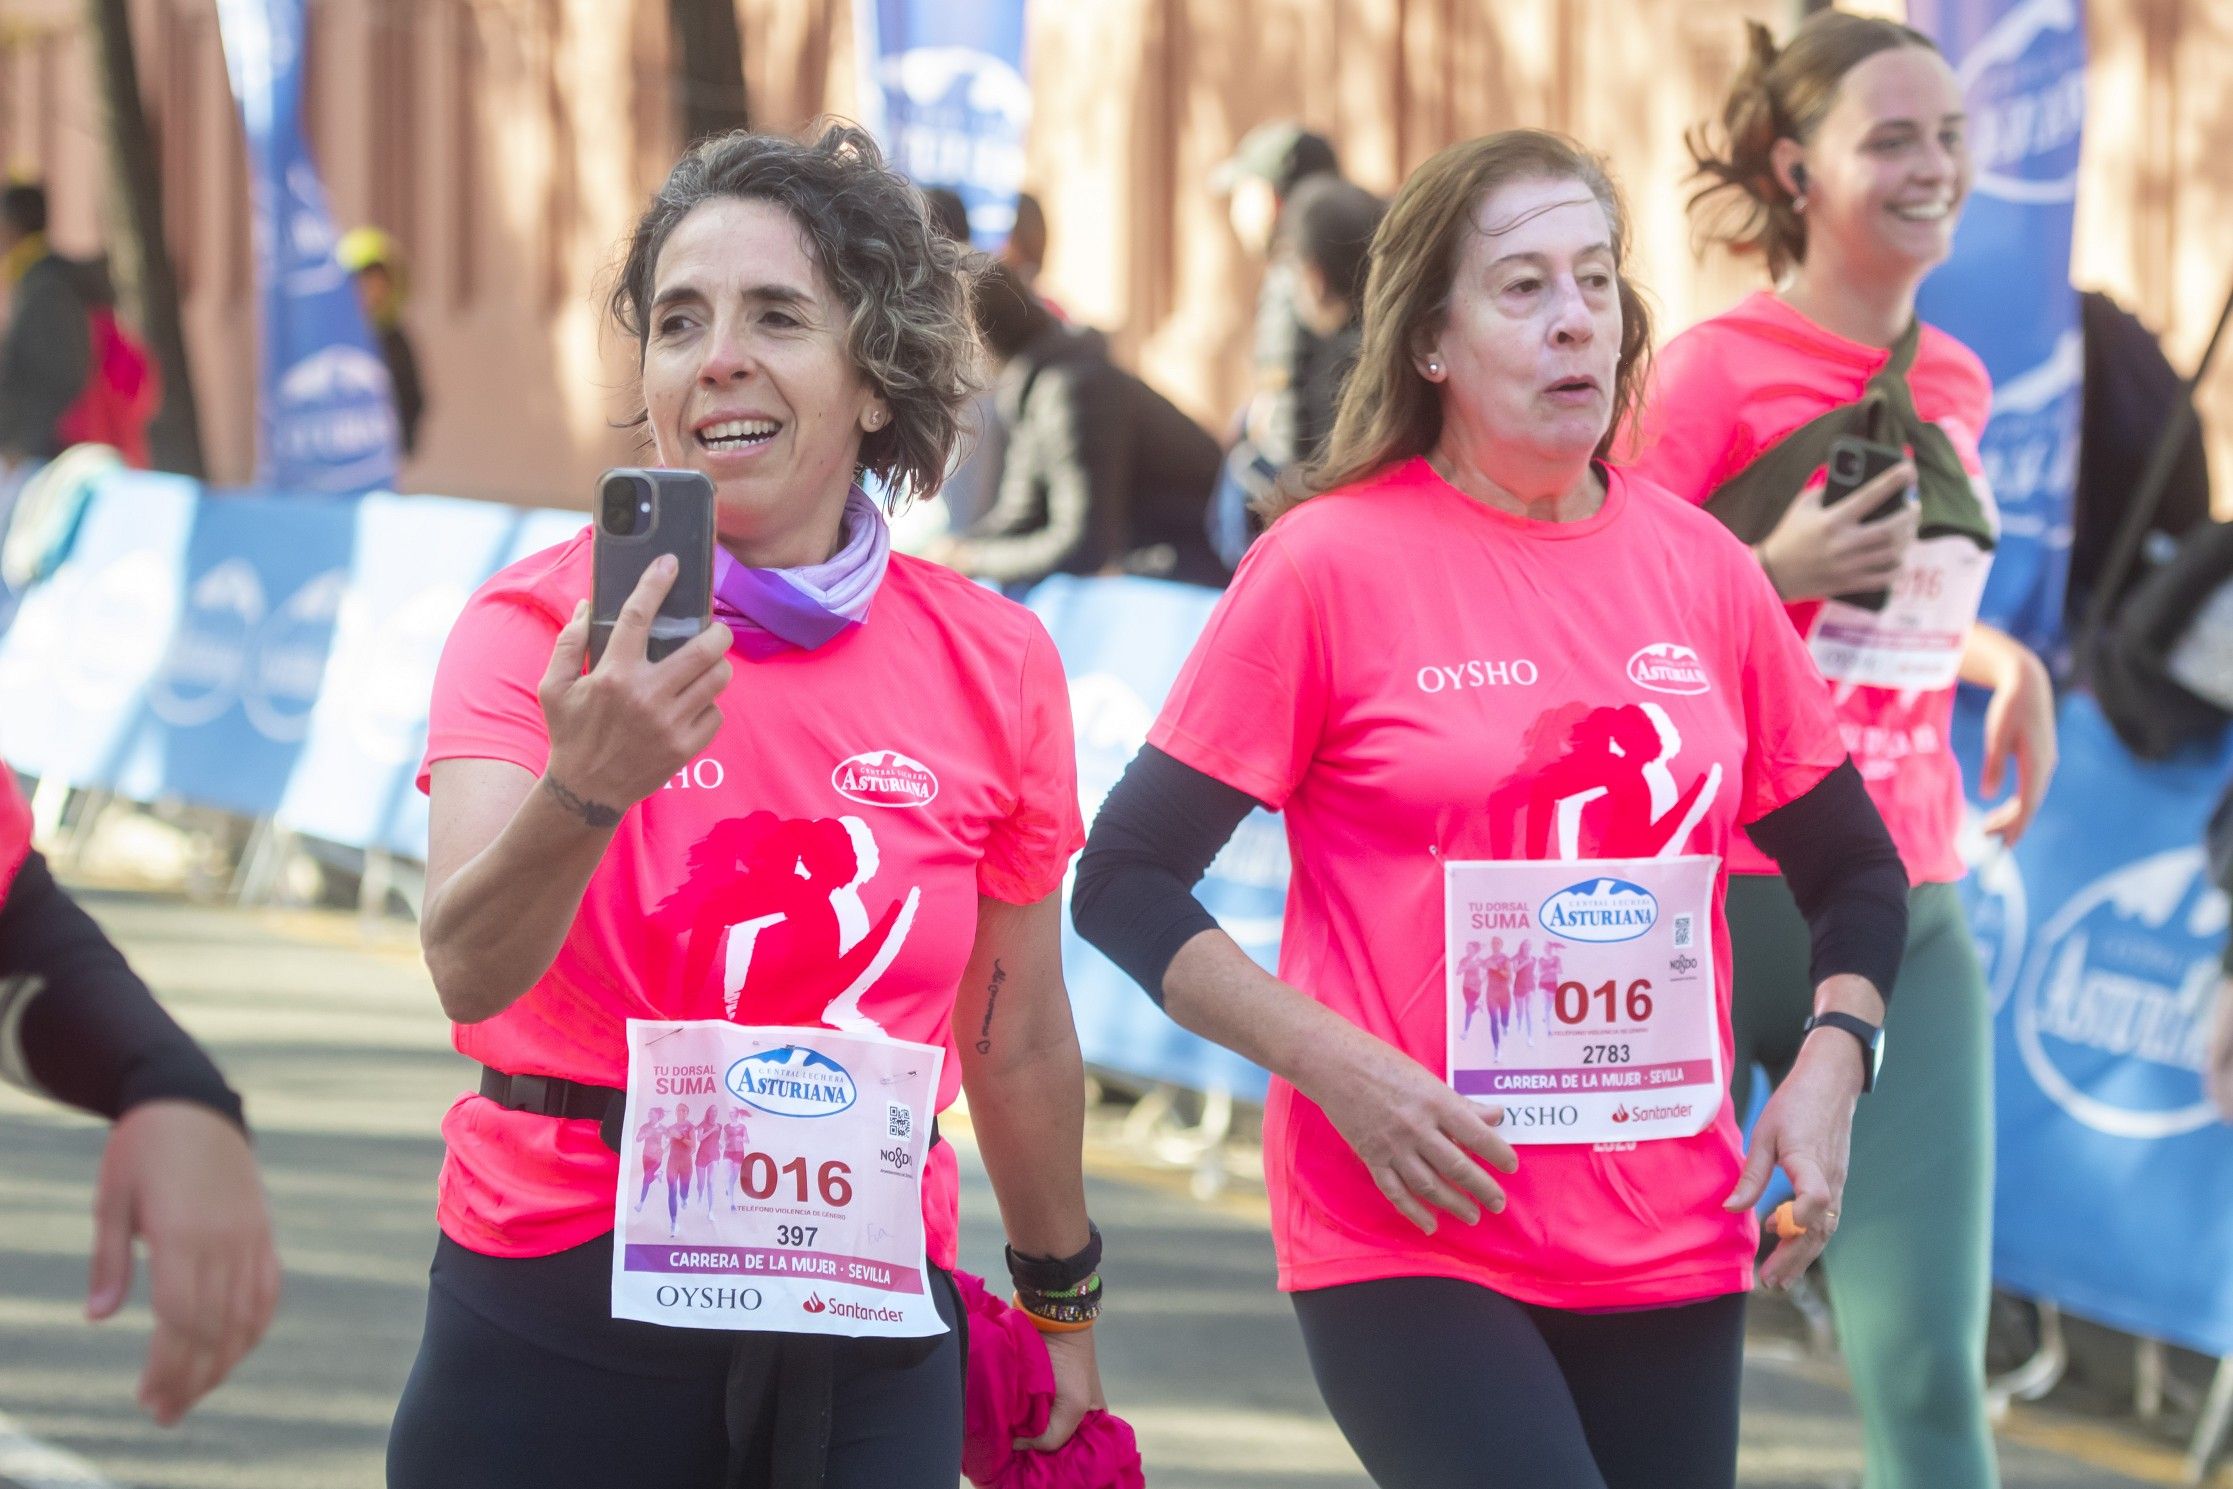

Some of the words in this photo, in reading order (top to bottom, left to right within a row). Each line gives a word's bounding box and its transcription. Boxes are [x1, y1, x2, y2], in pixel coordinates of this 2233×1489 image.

[1417, 659, 1538, 693] OYSHO
[841, 767, 930, 798] ASTURIANA
[1468, 902, 1483, 912] TU
[1486, 901, 1529, 912] DORSAL
[1550, 902, 1652, 927] ASTURIANA
[1471, 913, 1530, 929] SUMA
[1554, 978, 1654, 1025] 016
[1583, 1044, 1631, 1064] 2783
[653, 1065, 669, 1076] TU
[672, 1064, 716, 1077] DORSAL
[758, 1067, 799, 1079] CENTRAL
[803, 1071, 845, 1083] LECHERA
[1494, 1074, 1558, 1089] CARRERA
[1561, 1074, 1579, 1088] DE
[1582, 1073, 1599, 1088] LA
[1601, 1072, 1642, 1087] MUJER
[1650, 1068, 1685, 1084] SEVILLA
[655, 1076, 717, 1095] SUMA
[736, 1066, 848, 1104] ASTURIANA
[1632, 1104, 1692, 1122] Santander
[739, 1151, 853, 1208] 016
[775, 1206, 811, 1216] VIOLENCIA
[777, 1224, 818, 1247] 397
[669, 1252, 740, 1269] CARRERA
[745, 1254, 764, 1270] DE
[769, 1255, 788, 1271] LA
[791, 1256, 837, 1276] MUJER
[848, 1263, 891, 1285] SEVILLA
[656, 1285, 763, 1310] OYSHO
[828, 1297, 904, 1323] Santander
